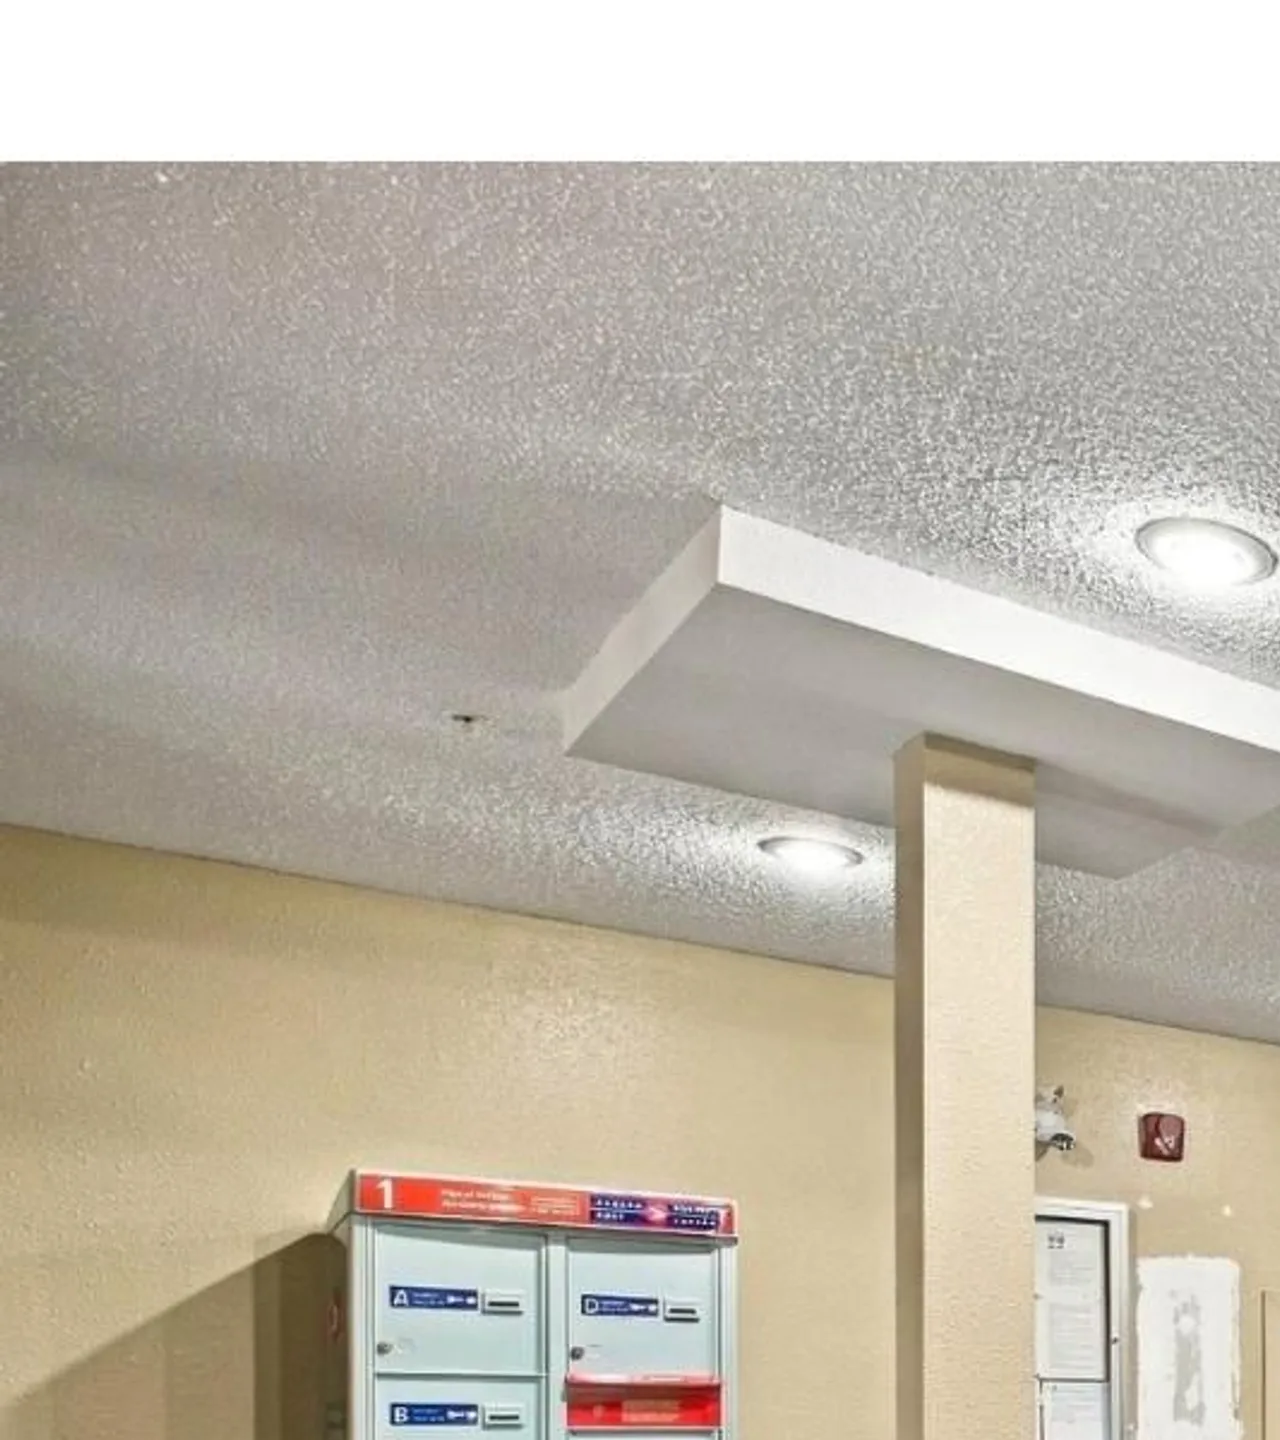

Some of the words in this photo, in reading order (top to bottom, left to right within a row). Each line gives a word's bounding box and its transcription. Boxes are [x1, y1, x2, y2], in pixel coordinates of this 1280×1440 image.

[375, 1178, 393, 1208] 1
[393, 1289, 409, 1306] A
[585, 1298, 599, 1314] D
[394, 1406, 409, 1423] B
